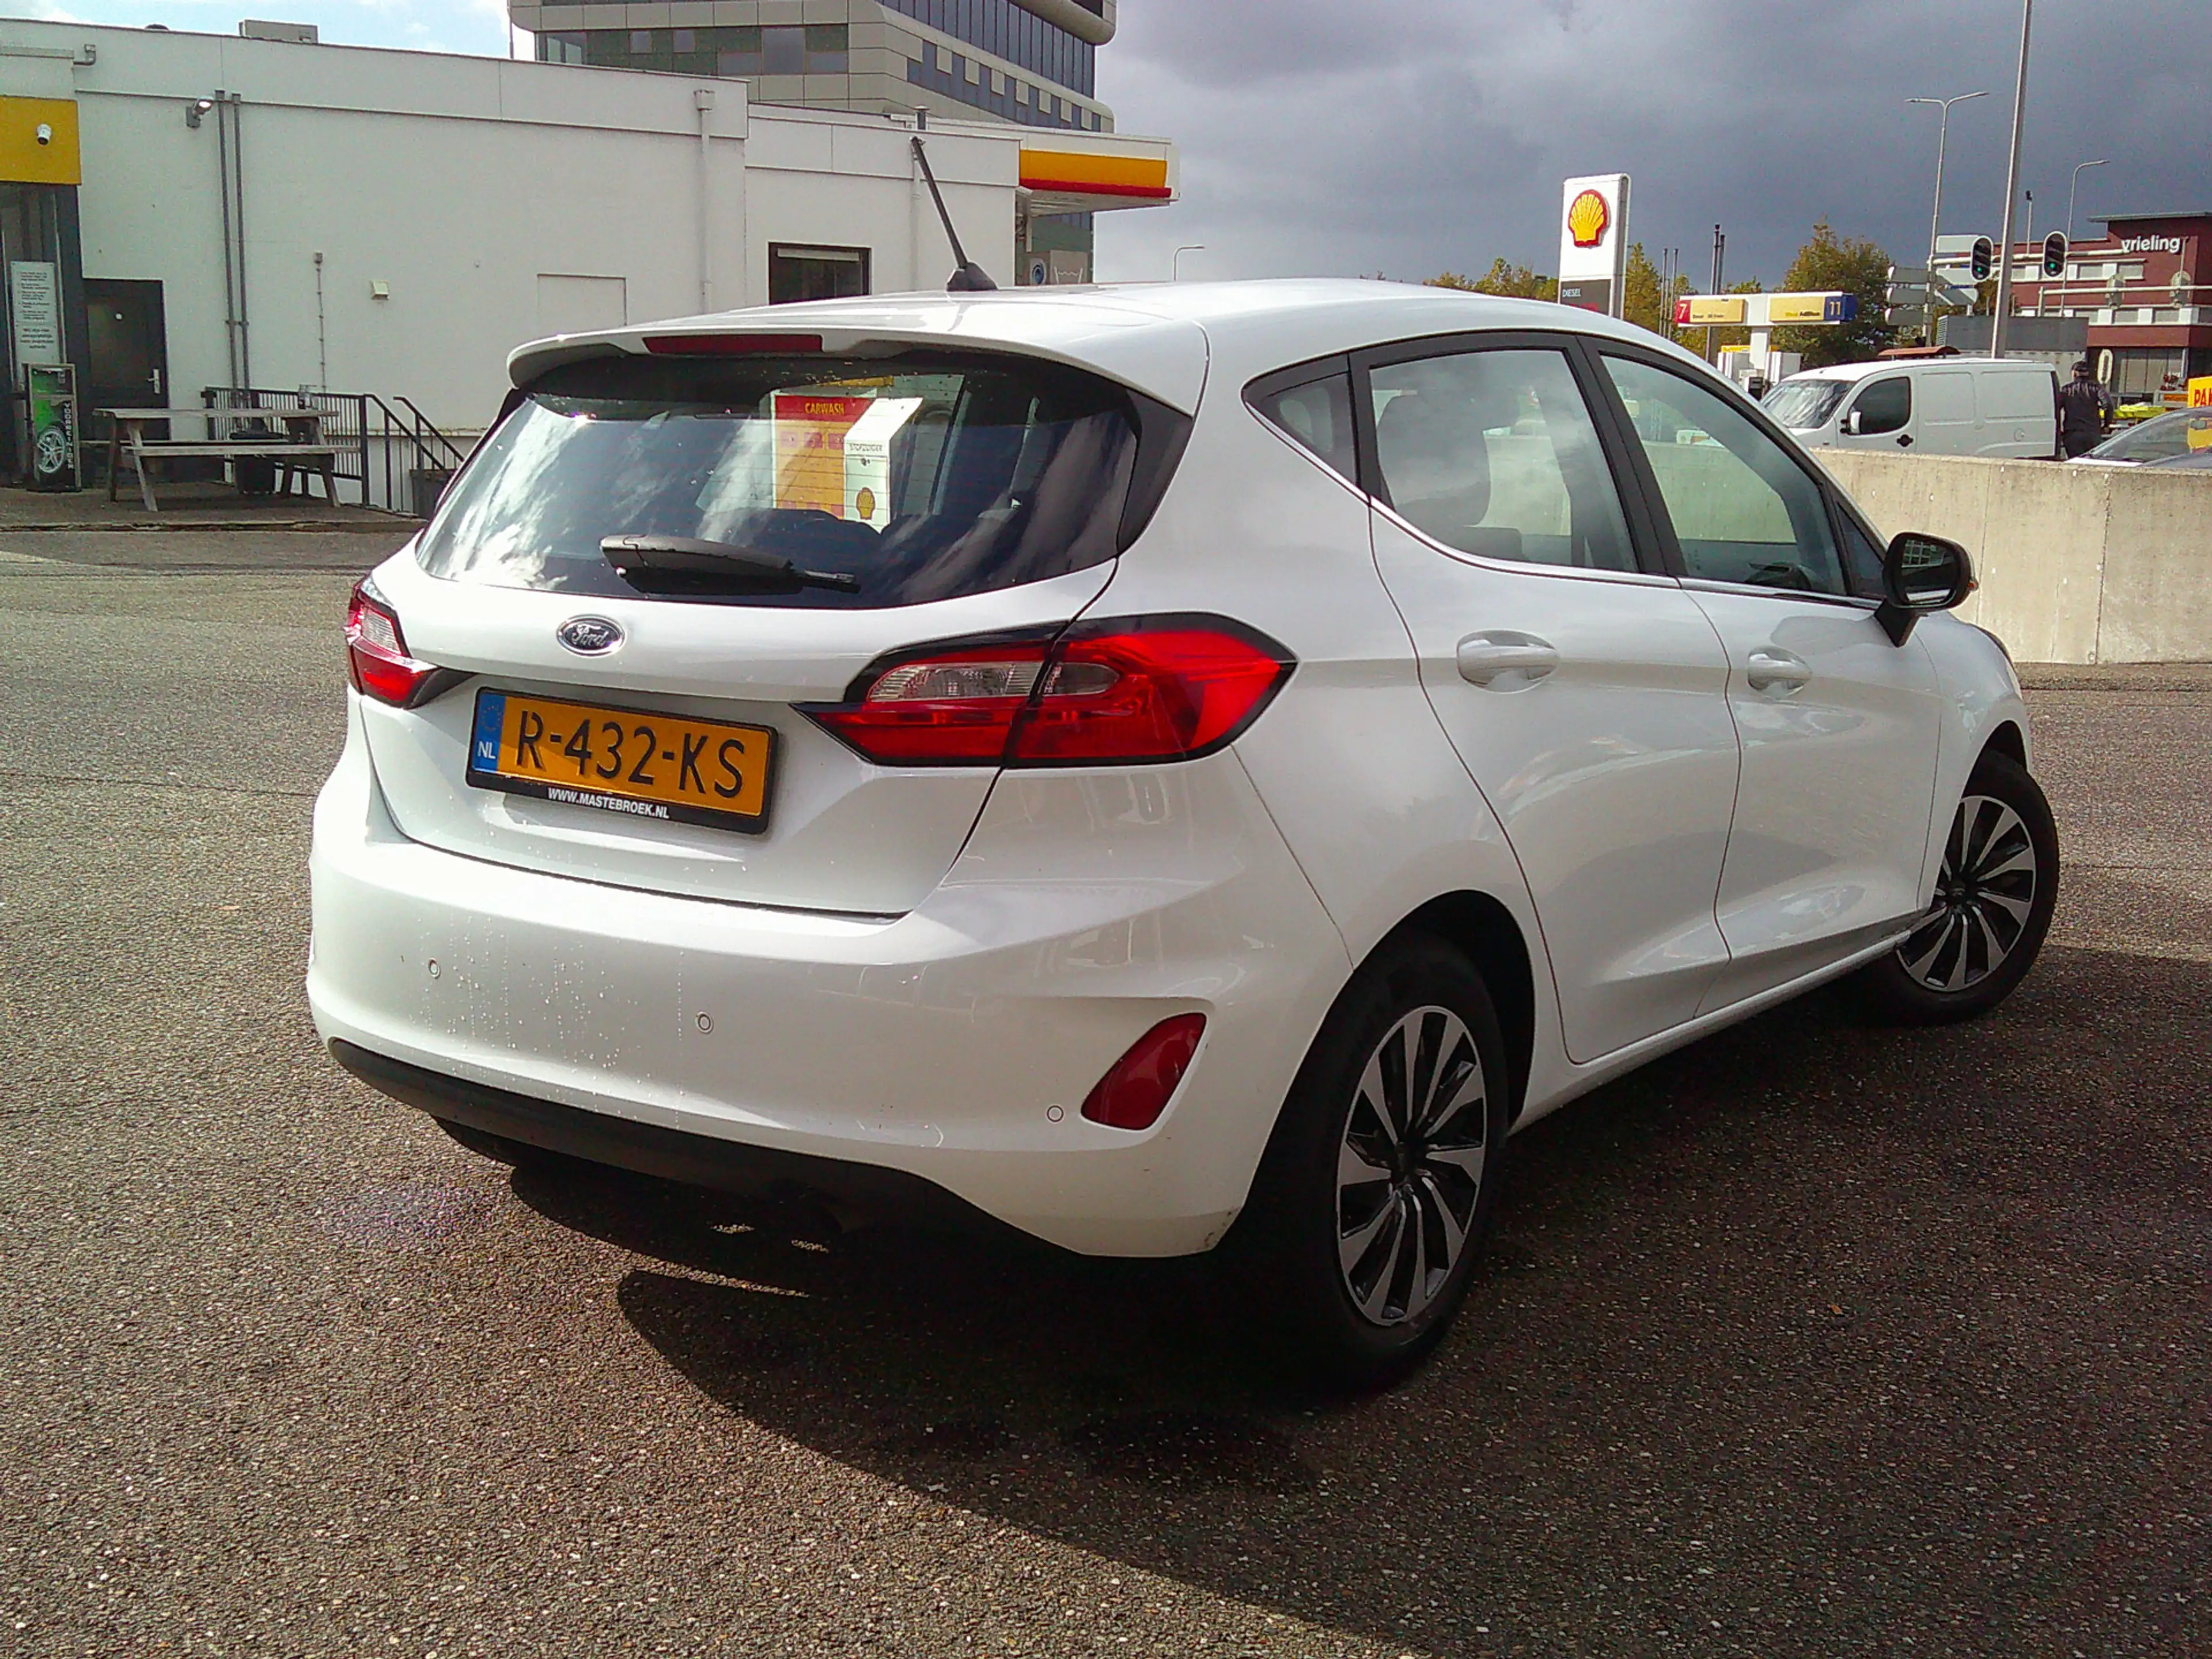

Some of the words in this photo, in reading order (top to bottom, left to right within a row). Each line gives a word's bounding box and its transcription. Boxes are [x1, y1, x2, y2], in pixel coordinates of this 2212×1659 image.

[2121, 235, 2181, 254] vrieling
[1562, 288, 1581, 298] DIESEL
[1679, 303, 1688, 320] 7
[1830, 301, 1841, 316] 11
[805, 403, 844, 415] CARWASH
[571, 624, 609, 647] Ford
[478, 740, 497, 759] NL
[516, 709, 745, 799] R-432-KS
[548, 787, 669, 819] WWW.MASTEBROEK.NL
